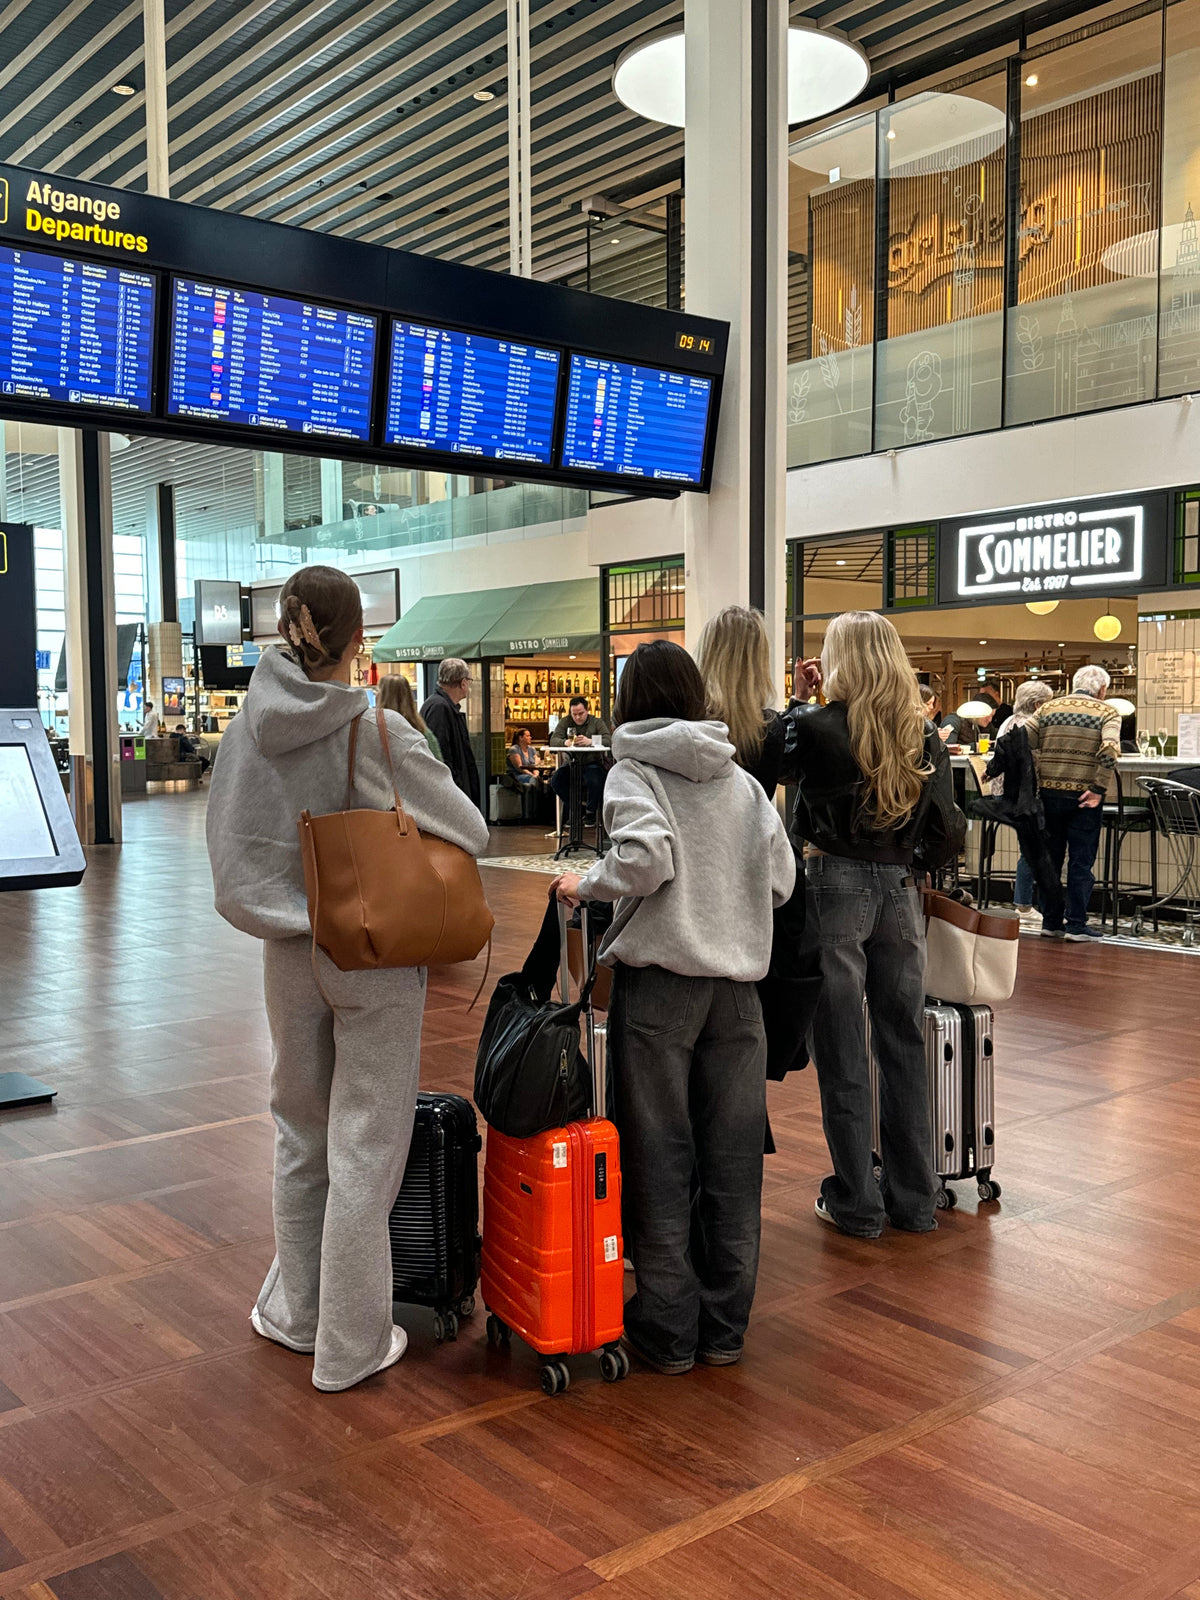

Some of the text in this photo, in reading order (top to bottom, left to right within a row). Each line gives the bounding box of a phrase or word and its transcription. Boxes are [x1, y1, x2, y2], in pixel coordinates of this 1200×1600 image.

[26, 180, 121, 222] Afgange
[26, 208, 148, 253] Departures
[1016, 511, 1078, 532] BISTRO
[975, 527, 1122, 583] SOMMELIER
[395, 648, 421, 658] BISTRO
[510, 636, 569, 651] BISTRO SOMMELIER
